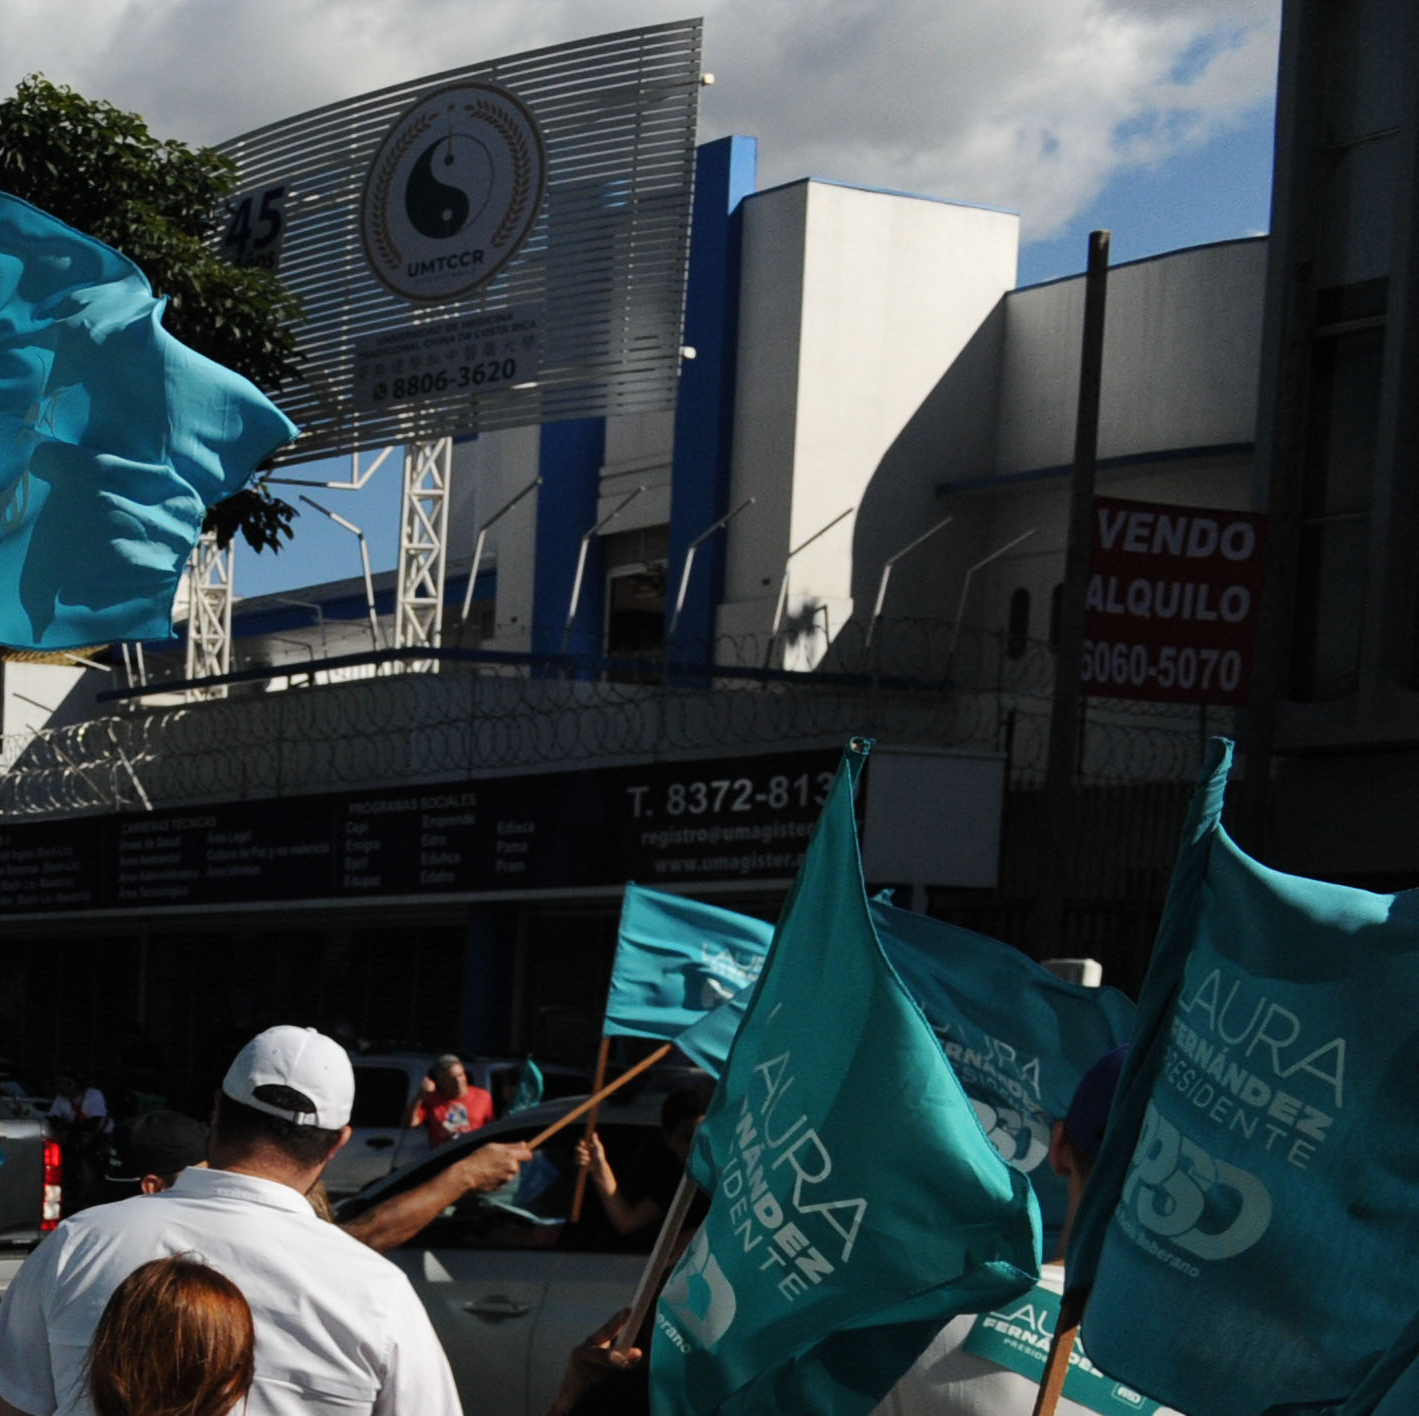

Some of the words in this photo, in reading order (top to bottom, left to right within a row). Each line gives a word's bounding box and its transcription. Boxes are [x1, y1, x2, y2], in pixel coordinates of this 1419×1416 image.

[226, 186, 285, 253] 45
[407, 249, 485, 278] UMTCCR
[392, 358, 517, 399] 8806-3620
[1097, 507, 1256, 562] VENDO
[1085, 573, 1251, 624] ALQUILO
[627, 786, 654, 818] T.
[666, 772, 835, 816] 8372-813
[640, 820, 814, 849] registro@umagister
